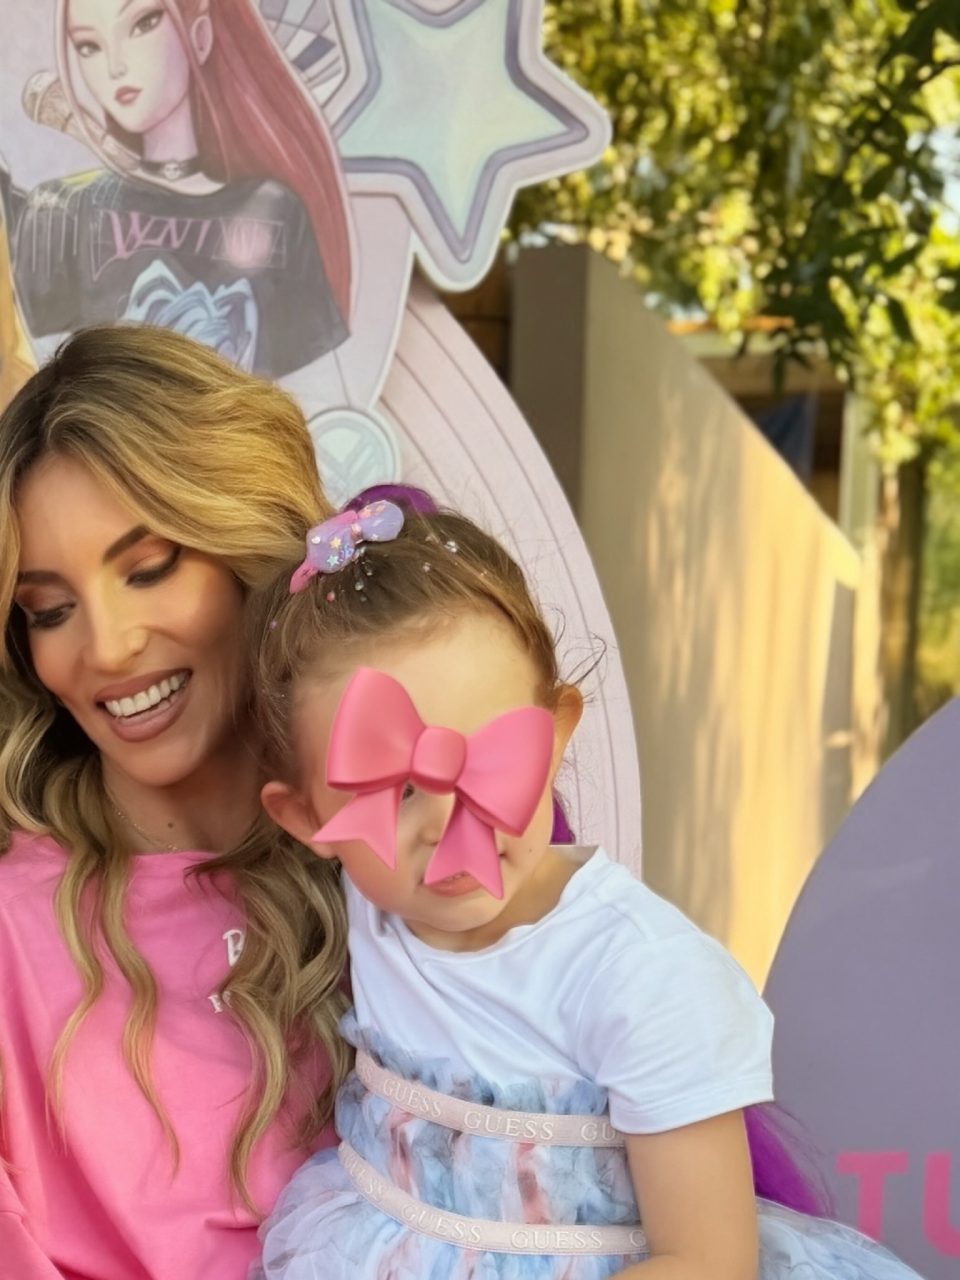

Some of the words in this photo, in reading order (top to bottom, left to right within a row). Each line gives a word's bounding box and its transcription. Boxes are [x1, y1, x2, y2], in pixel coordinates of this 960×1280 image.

[383, 1079, 441, 1118] GUESS
[463, 1110, 555, 1140] GUESS
[401, 1203, 482, 1243] GUESS
[511, 1230, 603, 1249] GUESS
